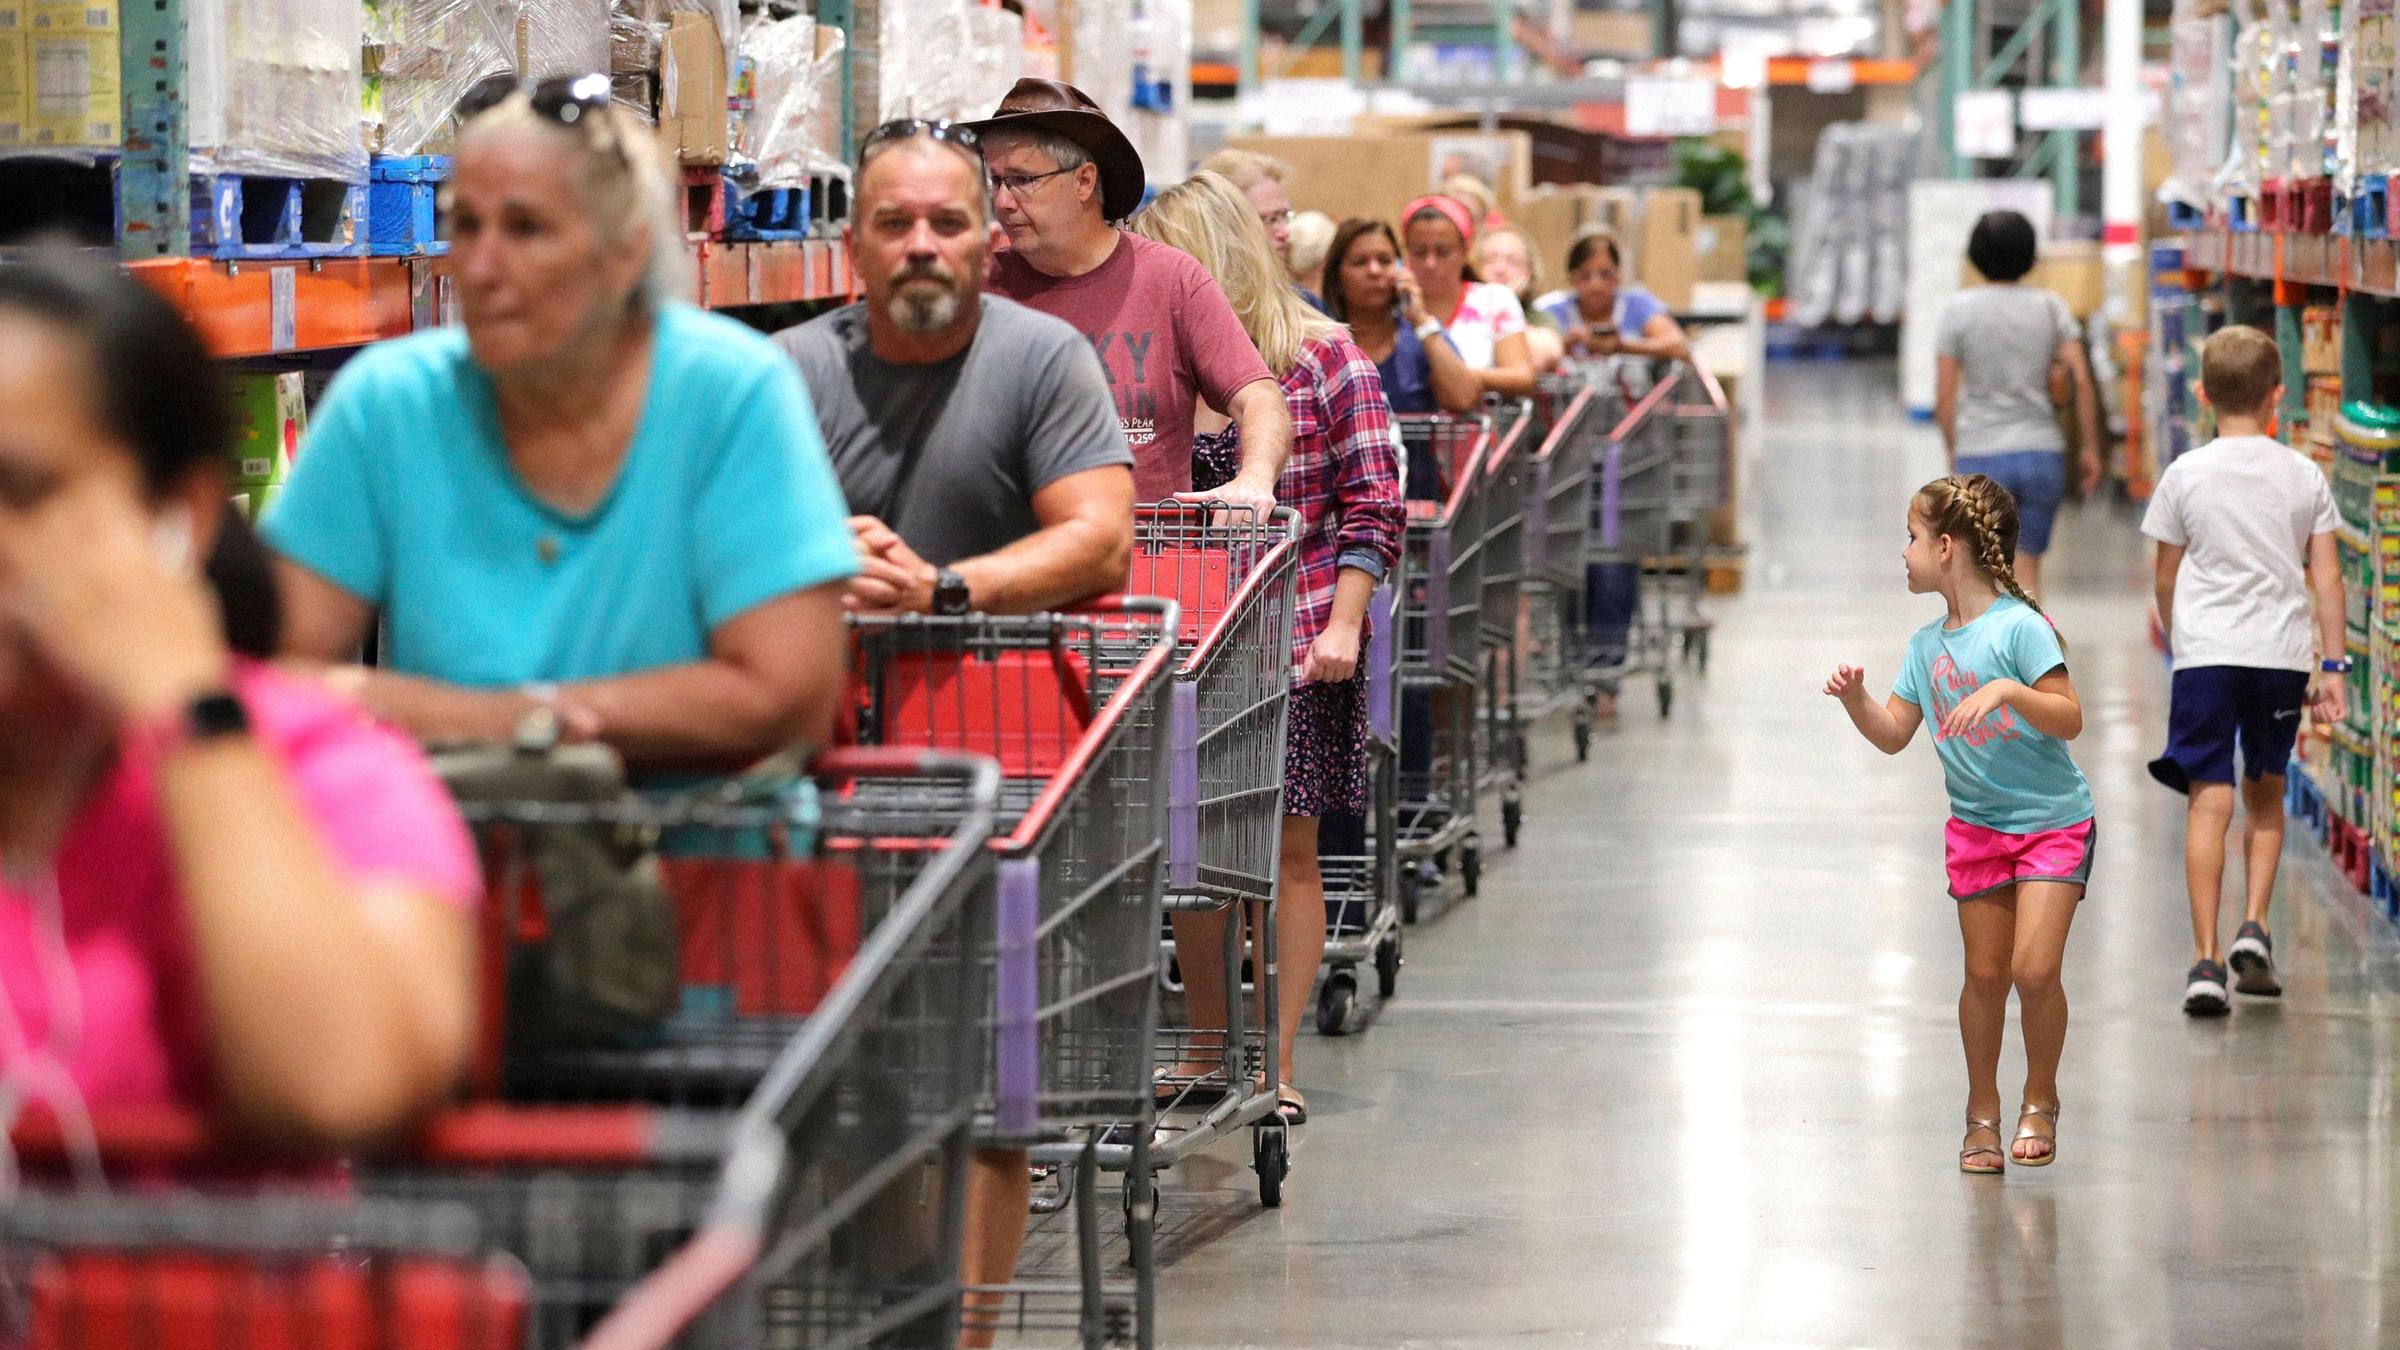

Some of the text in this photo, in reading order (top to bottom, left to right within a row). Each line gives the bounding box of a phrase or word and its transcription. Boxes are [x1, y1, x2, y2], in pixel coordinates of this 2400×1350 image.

[1087, 332, 1153, 384] KY
[1114, 386, 1155, 416] IN
[1117, 417, 1154, 429] GS PEAK
[1933, 655, 1979, 693] Play
